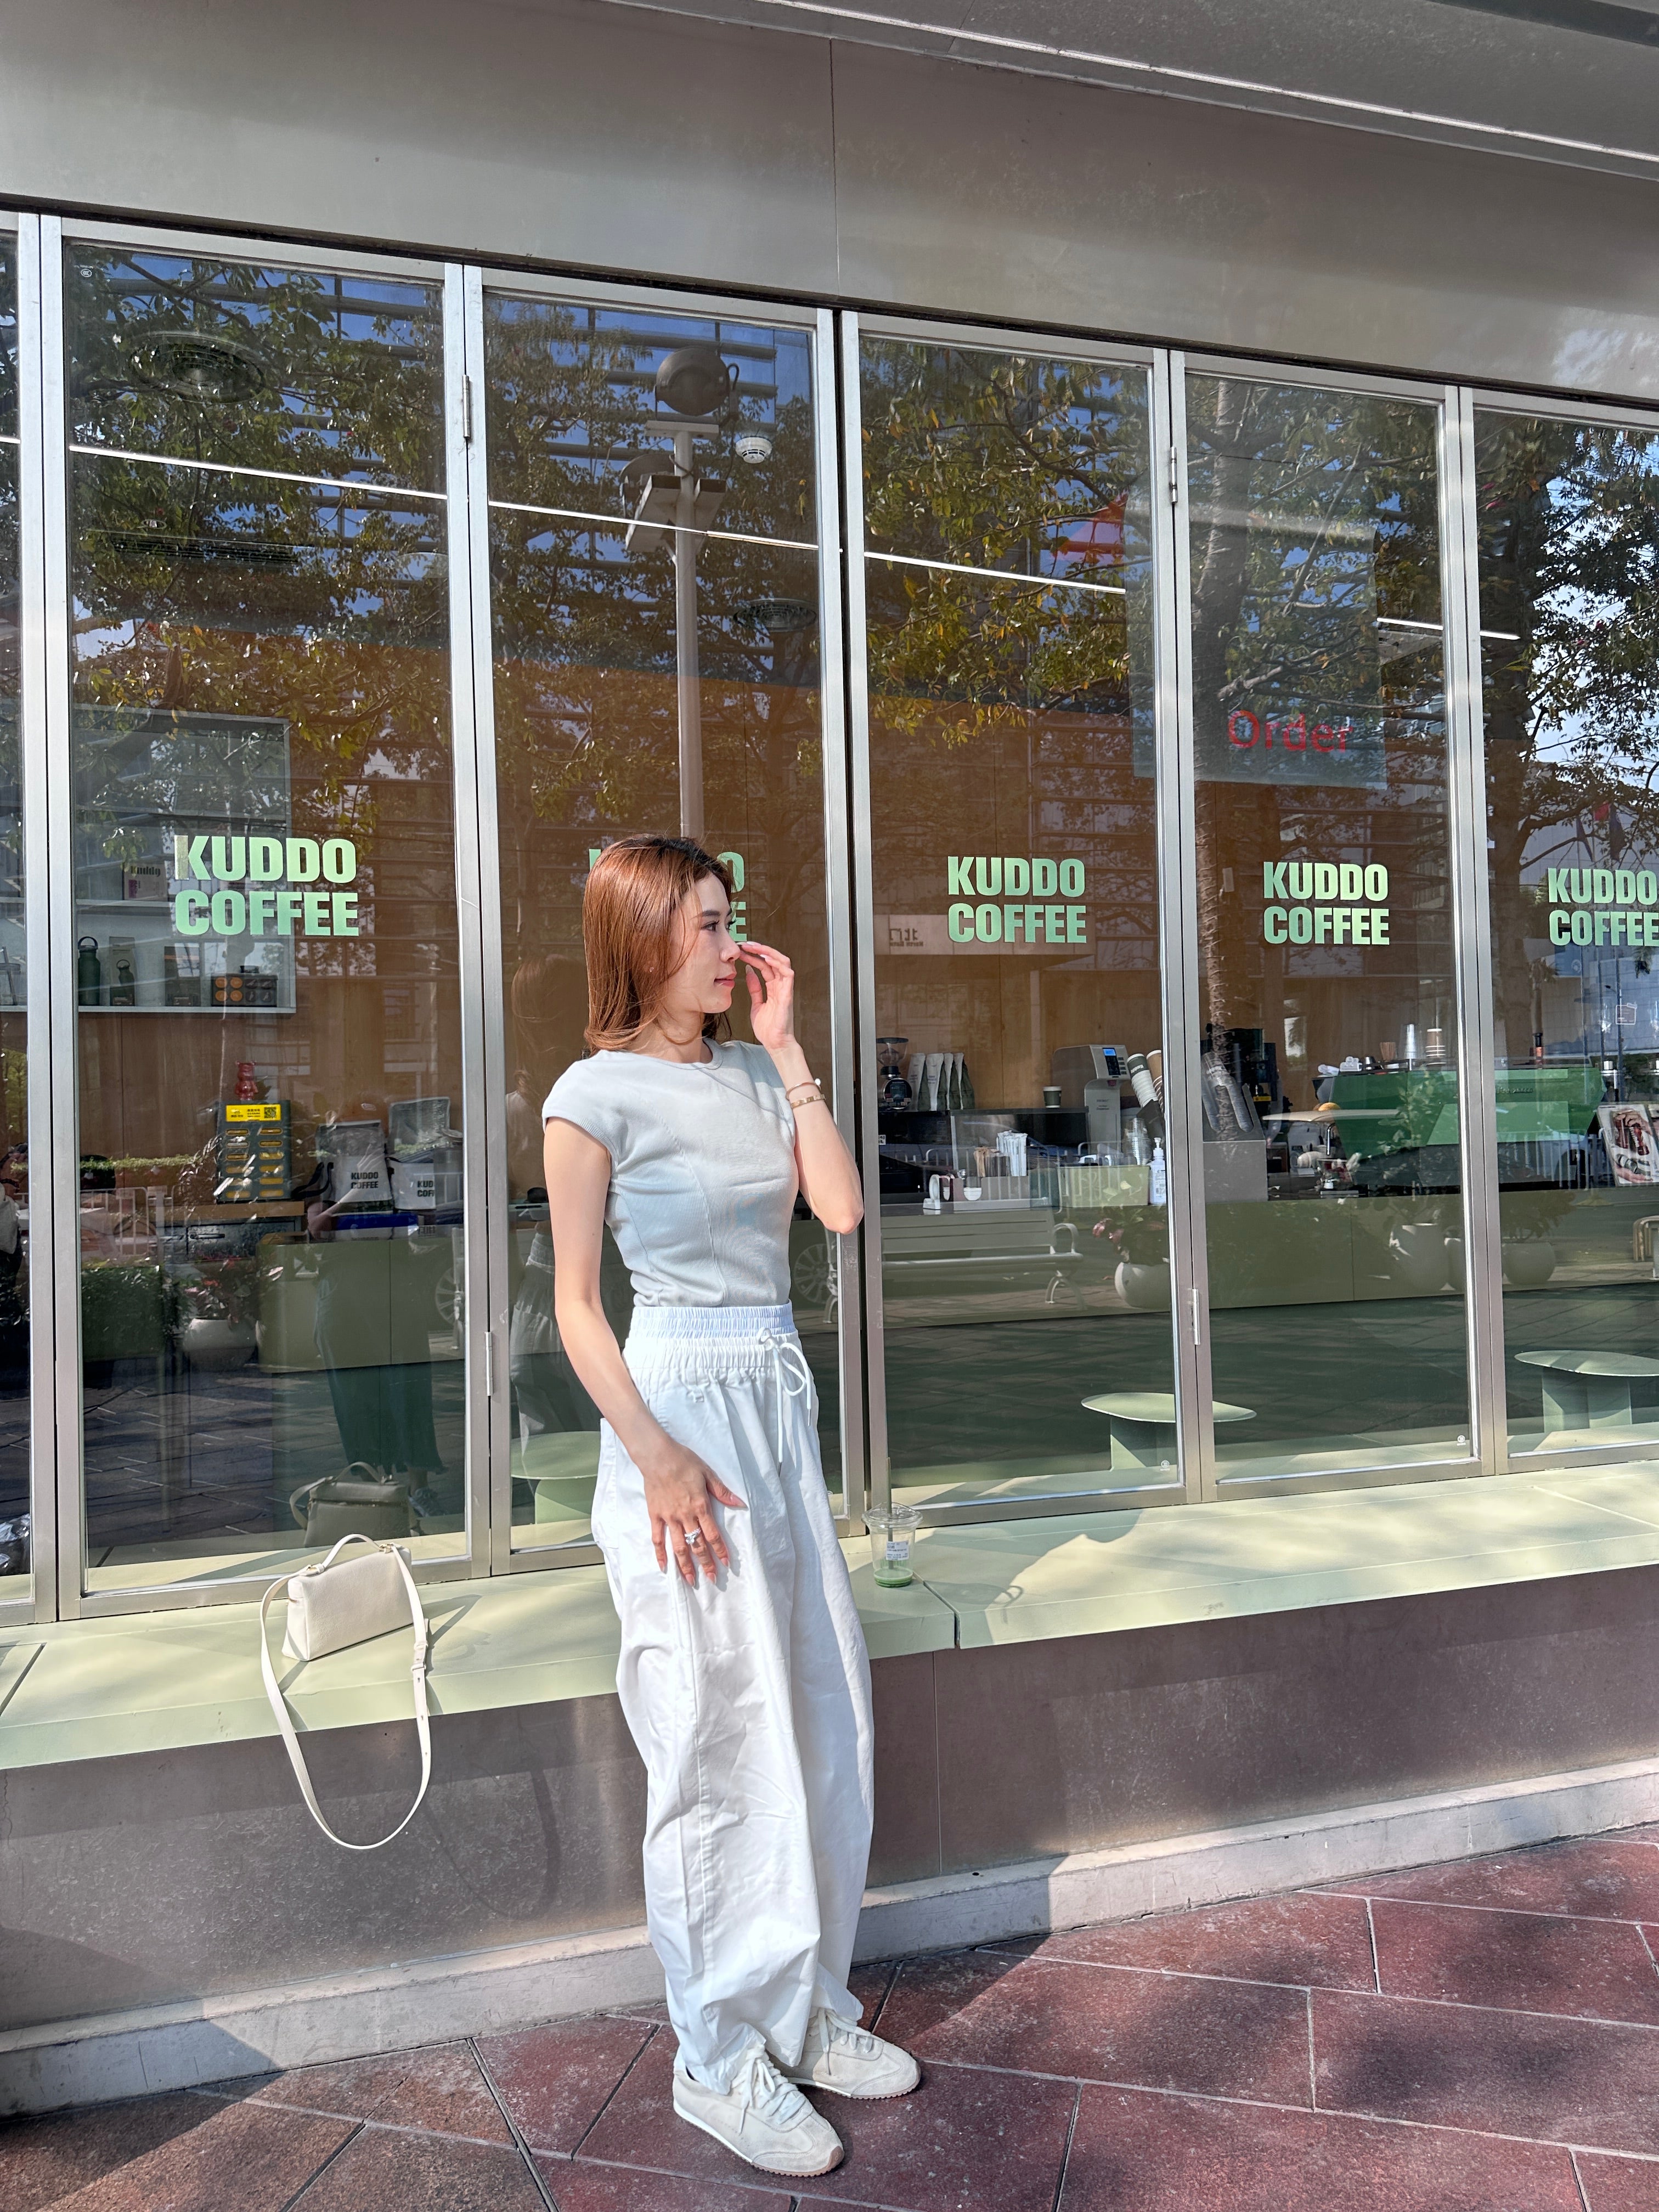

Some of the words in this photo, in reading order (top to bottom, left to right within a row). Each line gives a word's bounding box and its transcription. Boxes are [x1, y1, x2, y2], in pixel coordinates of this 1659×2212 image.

[1227, 709, 1354, 753] Order
[174, 835, 357, 883] KUDDO
[947, 856, 1085, 898] KUDDO
[1263, 861, 1388, 901] KUDDO
[1548, 867, 1657, 905] KUDDO
[175, 889, 359, 936] COFFEE
[948, 902, 1086, 943] COFFEE
[1263, 906, 1390, 945] COFFEE
[1549, 910, 1659, 946] COFFEE
[351, 1171, 379, 1180] KUDDO
